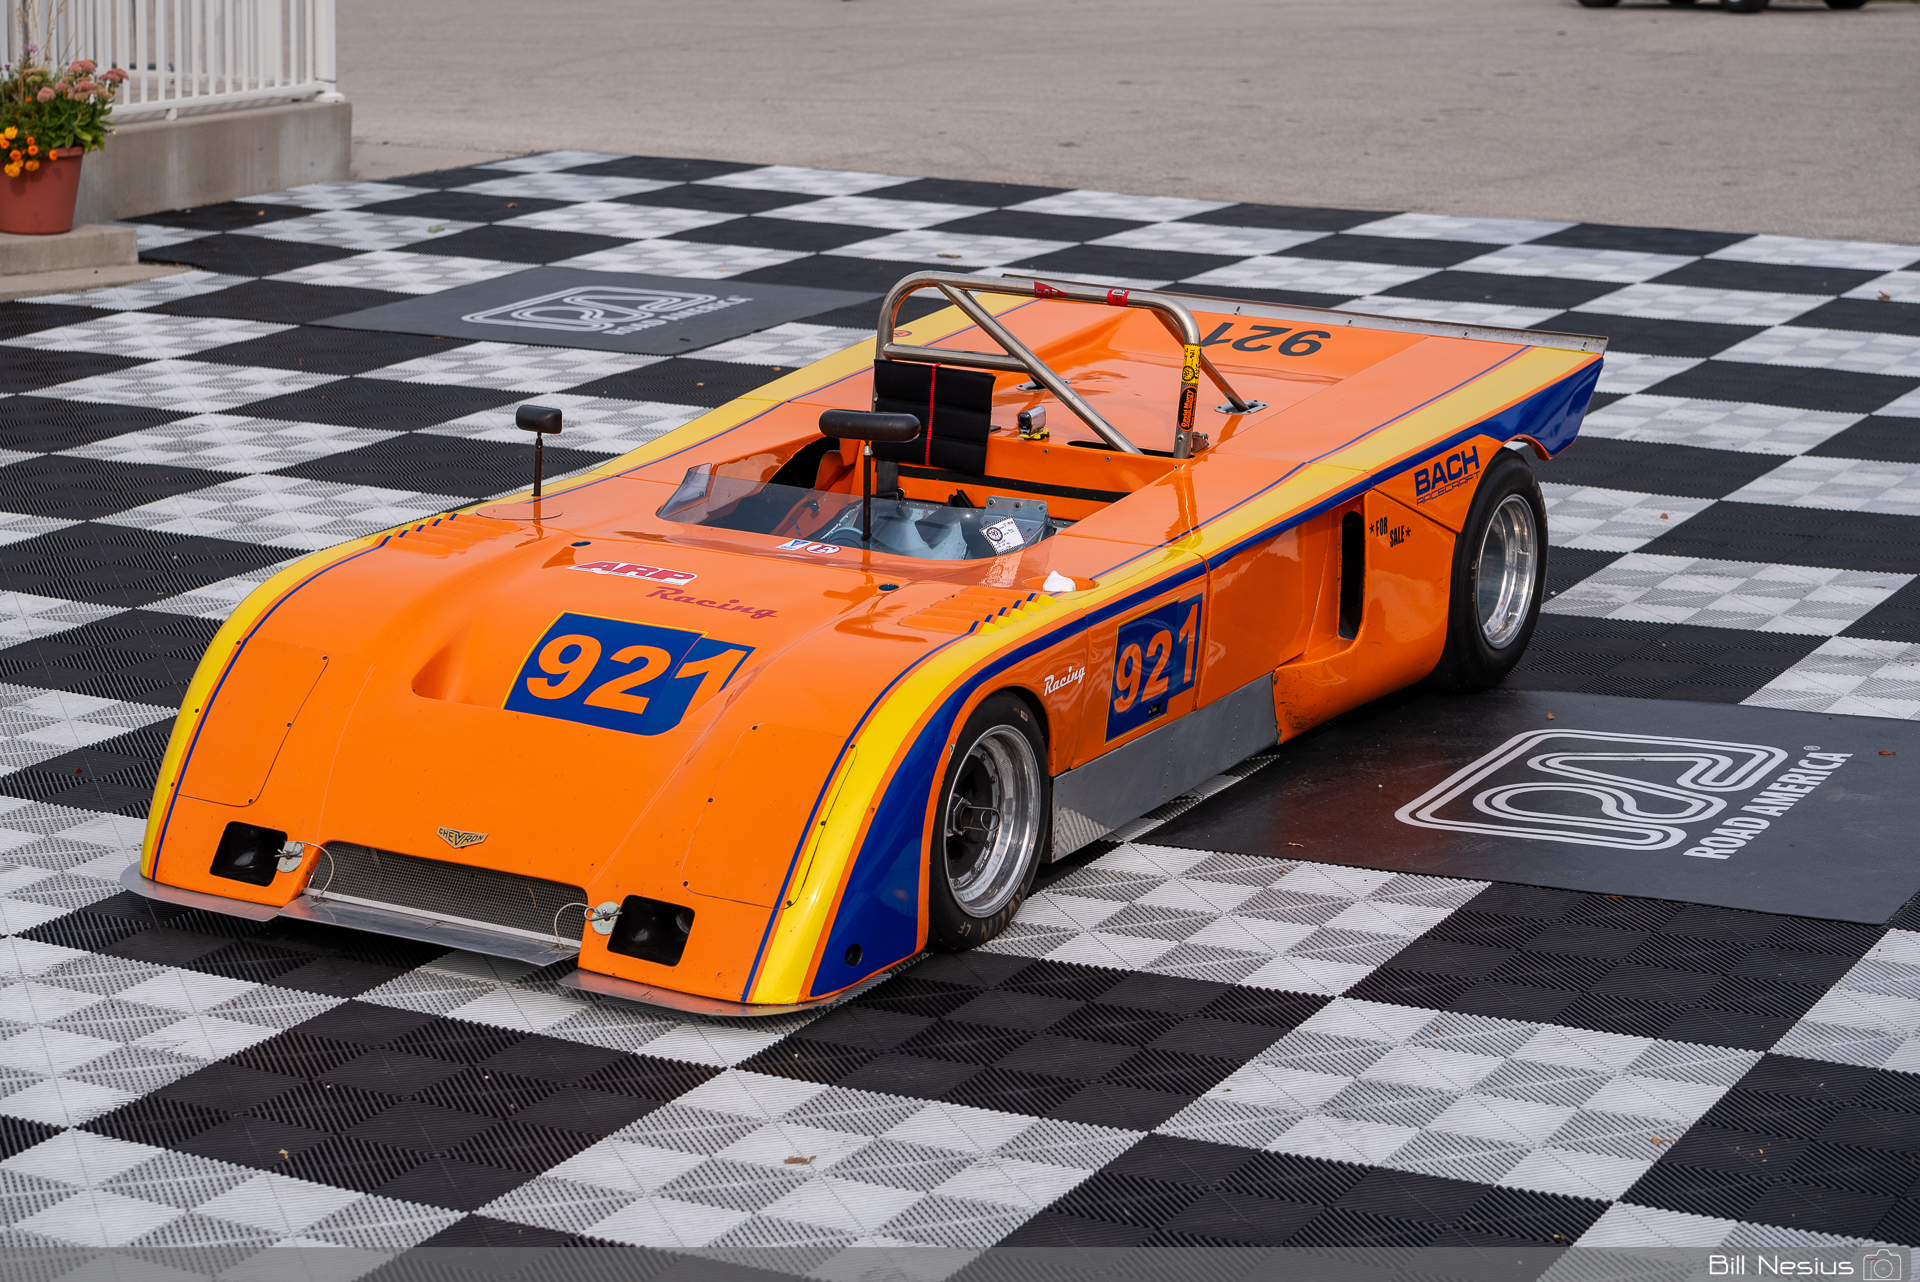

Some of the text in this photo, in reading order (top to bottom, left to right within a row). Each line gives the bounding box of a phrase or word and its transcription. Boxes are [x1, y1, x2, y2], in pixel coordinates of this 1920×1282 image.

[1200, 322, 1331, 357] 921
[1414, 445, 1480, 497] BACH
[1416, 470, 1480, 507] RACECRAFT
[575, 561, 696, 581] ARP
[646, 586, 778, 619] Racing
[1114, 603, 1199, 713] 921
[526, 634, 748, 724] 921
[1043, 666, 1086, 697] Racing
[1683, 752, 1854, 860] ROAD AMERICA
[438, 828, 485, 846] CHEVRON
